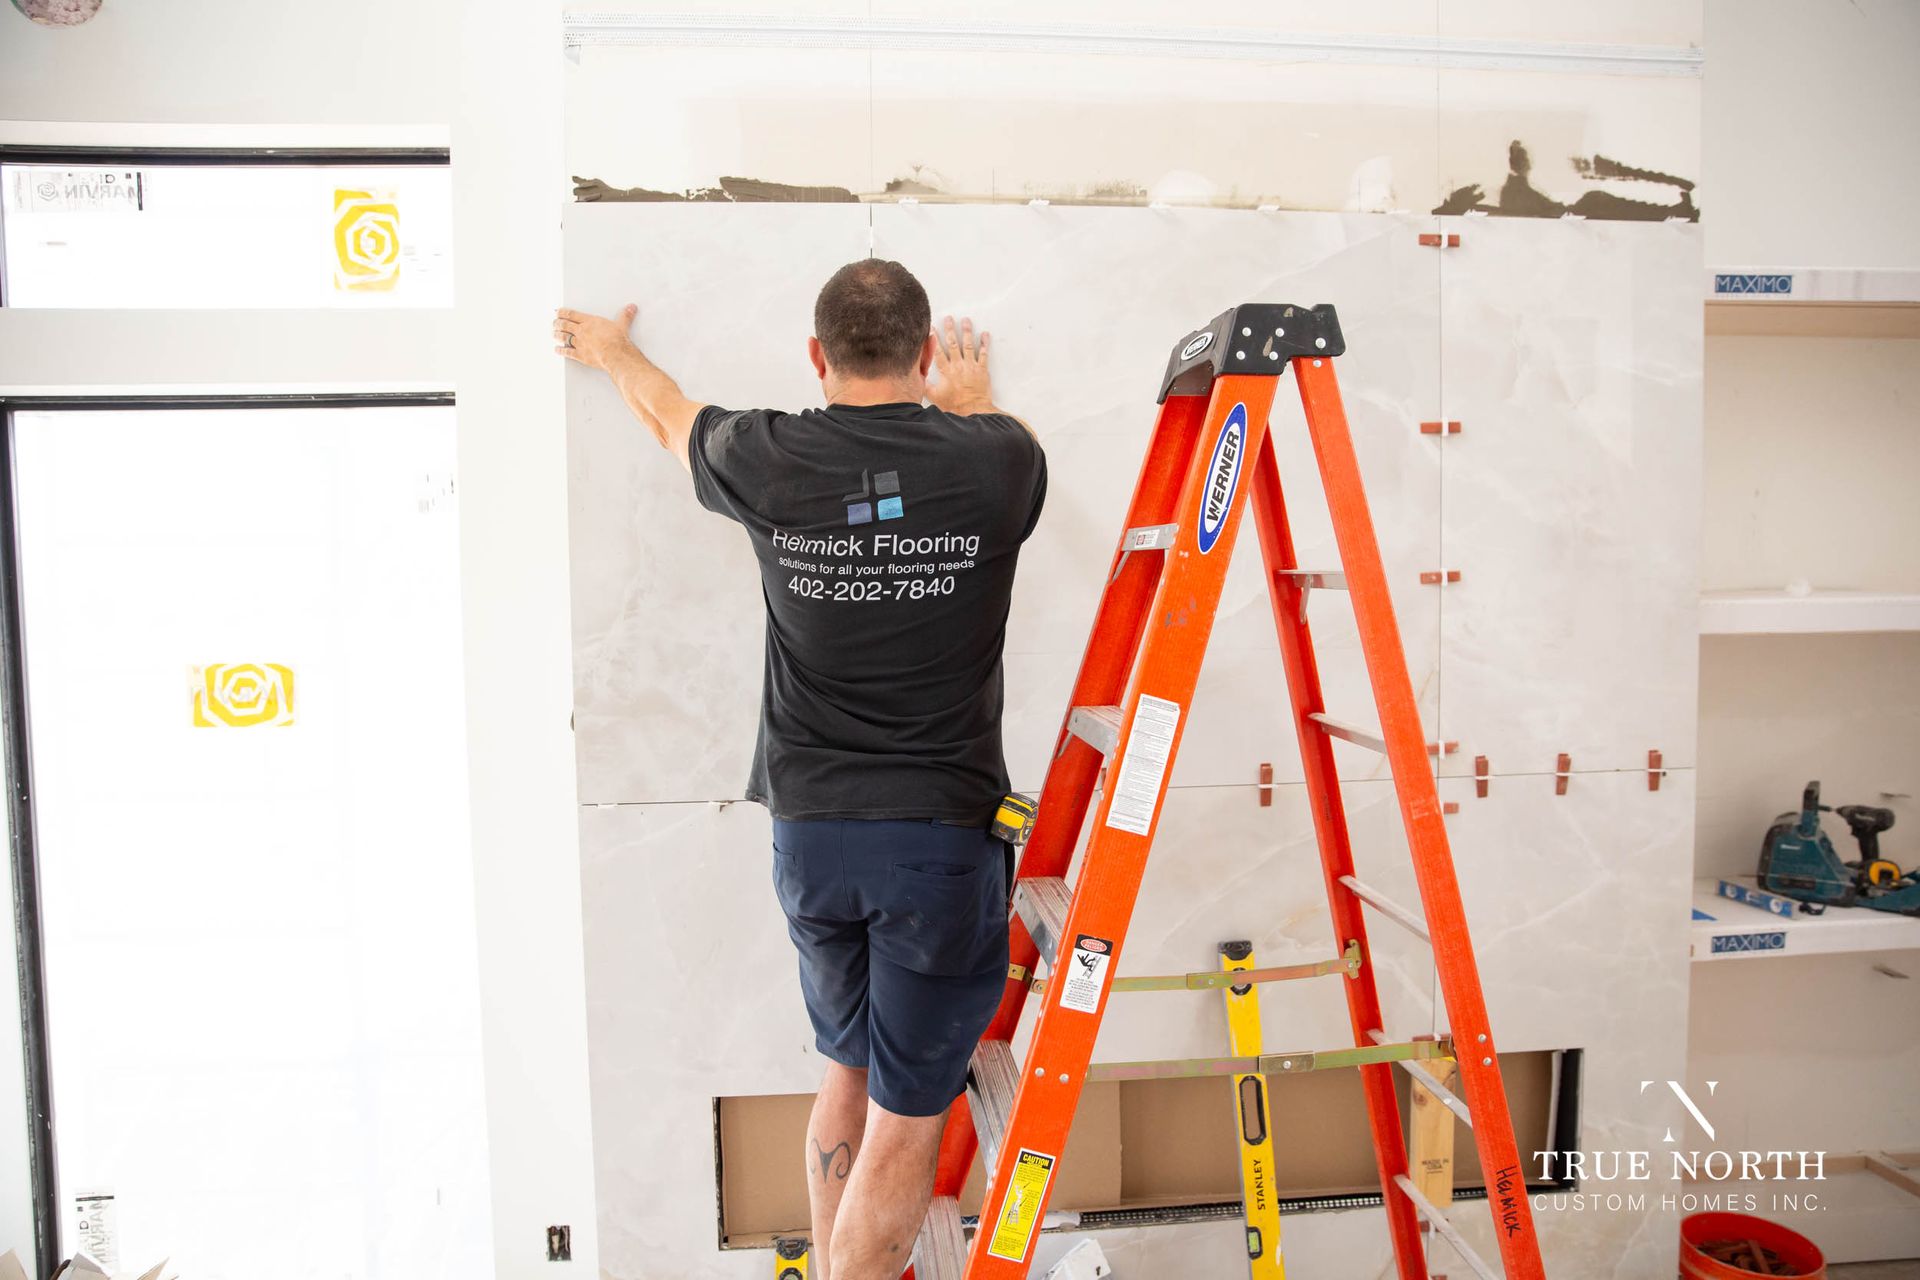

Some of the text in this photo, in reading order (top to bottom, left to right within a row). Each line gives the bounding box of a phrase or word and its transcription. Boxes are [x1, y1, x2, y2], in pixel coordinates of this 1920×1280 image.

[1715, 275, 1791, 293] MAXIMO
[1207, 430, 1240, 522] WERNER
[873, 531, 980, 556] Flooring
[778, 556, 975, 578] solutions for all your flooring needs
[788, 575, 955, 601] 402-202-7840
[1712, 933, 1785, 952] MAXIMO
[1253, 1159, 1266, 1211] STANLEY
